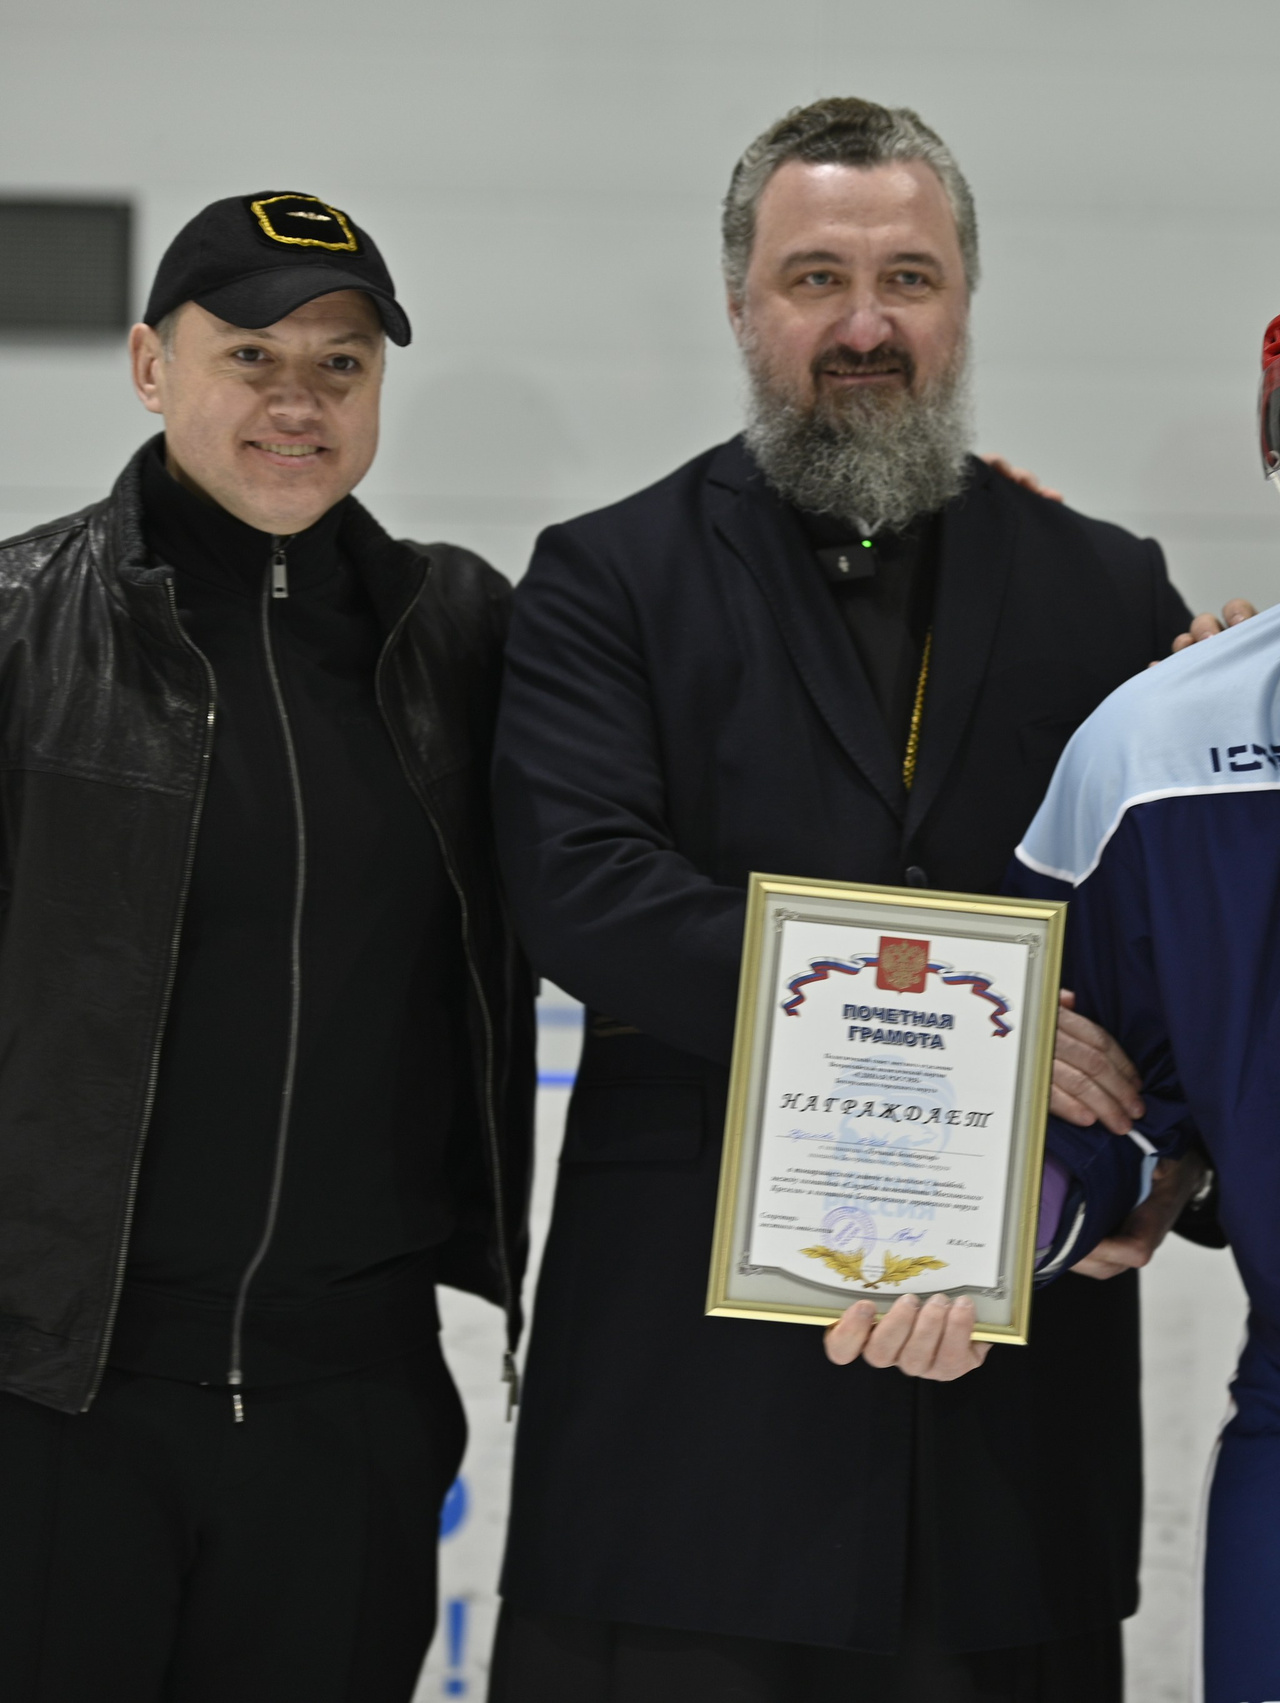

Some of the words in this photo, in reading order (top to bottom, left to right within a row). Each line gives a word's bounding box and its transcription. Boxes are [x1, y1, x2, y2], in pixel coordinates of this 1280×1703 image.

[842, 1003, 956, 1030] ПОЧЕТНАЯ
[847, 1025, 946, 1050] ГРАМОТА
[778, 1092, 995, 1128] НАГРАЖДАЕТ
